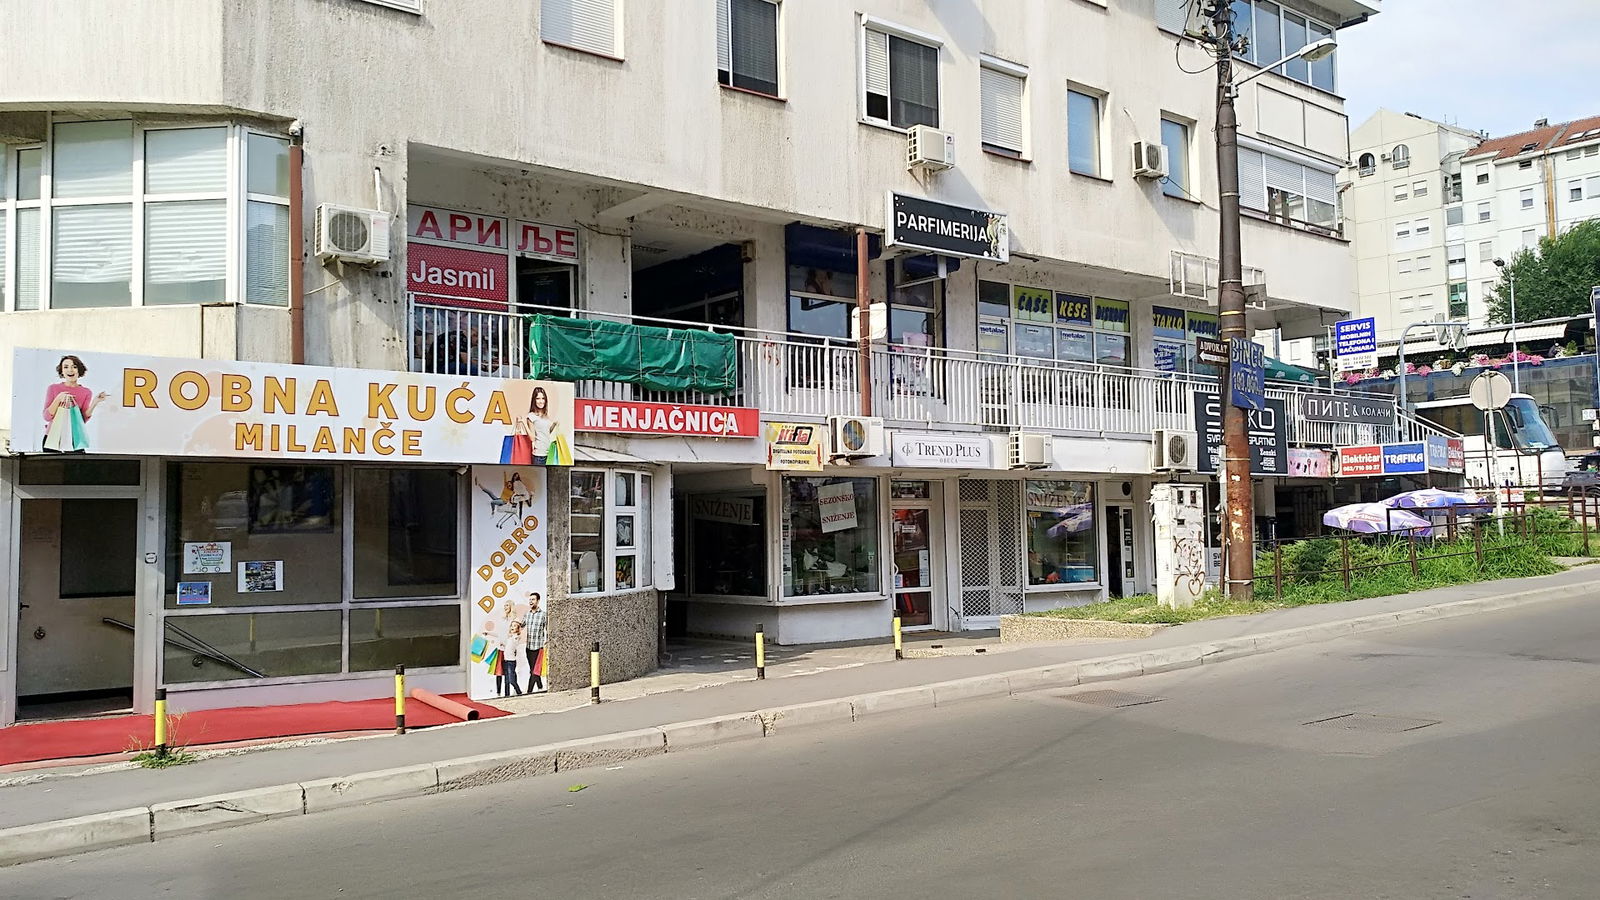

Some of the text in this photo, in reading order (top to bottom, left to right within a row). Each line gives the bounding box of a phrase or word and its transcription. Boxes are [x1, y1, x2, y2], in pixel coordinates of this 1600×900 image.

[897, 211, 988, 243] PARFIMERIJA
[412, 260, 495, 291] Jasmil
[1059, 300, 1088, 319] KESE
[1062, 332, 1086, 340] metalac
[1340, 322, 1370, 332] SERVIS
[1200, 341, 1228, 354] ADVOKAT
[1232, 337, 1264, 369] BINGO
[122, 367, 512, 426] ROBNA KUĆA
[1308, 399, 1349, 418] ПИТЕ
[1352, 406, 1359, 417] &
[583, 404, 739, 433] MENJAČNICA
[234, 421, 423, 456] MILANČE
[1248, 437, 1276, 447] SPLATNO
[915, 441, 981, 458] TREND PLUS
[1384, 452, 1424, 464] TRAFIKA
[819, 494, 854, 506] SEZONSKO
[477, 515, 539, 581] DOBRO
[478, 543, 542, 614] DOŠLI!
